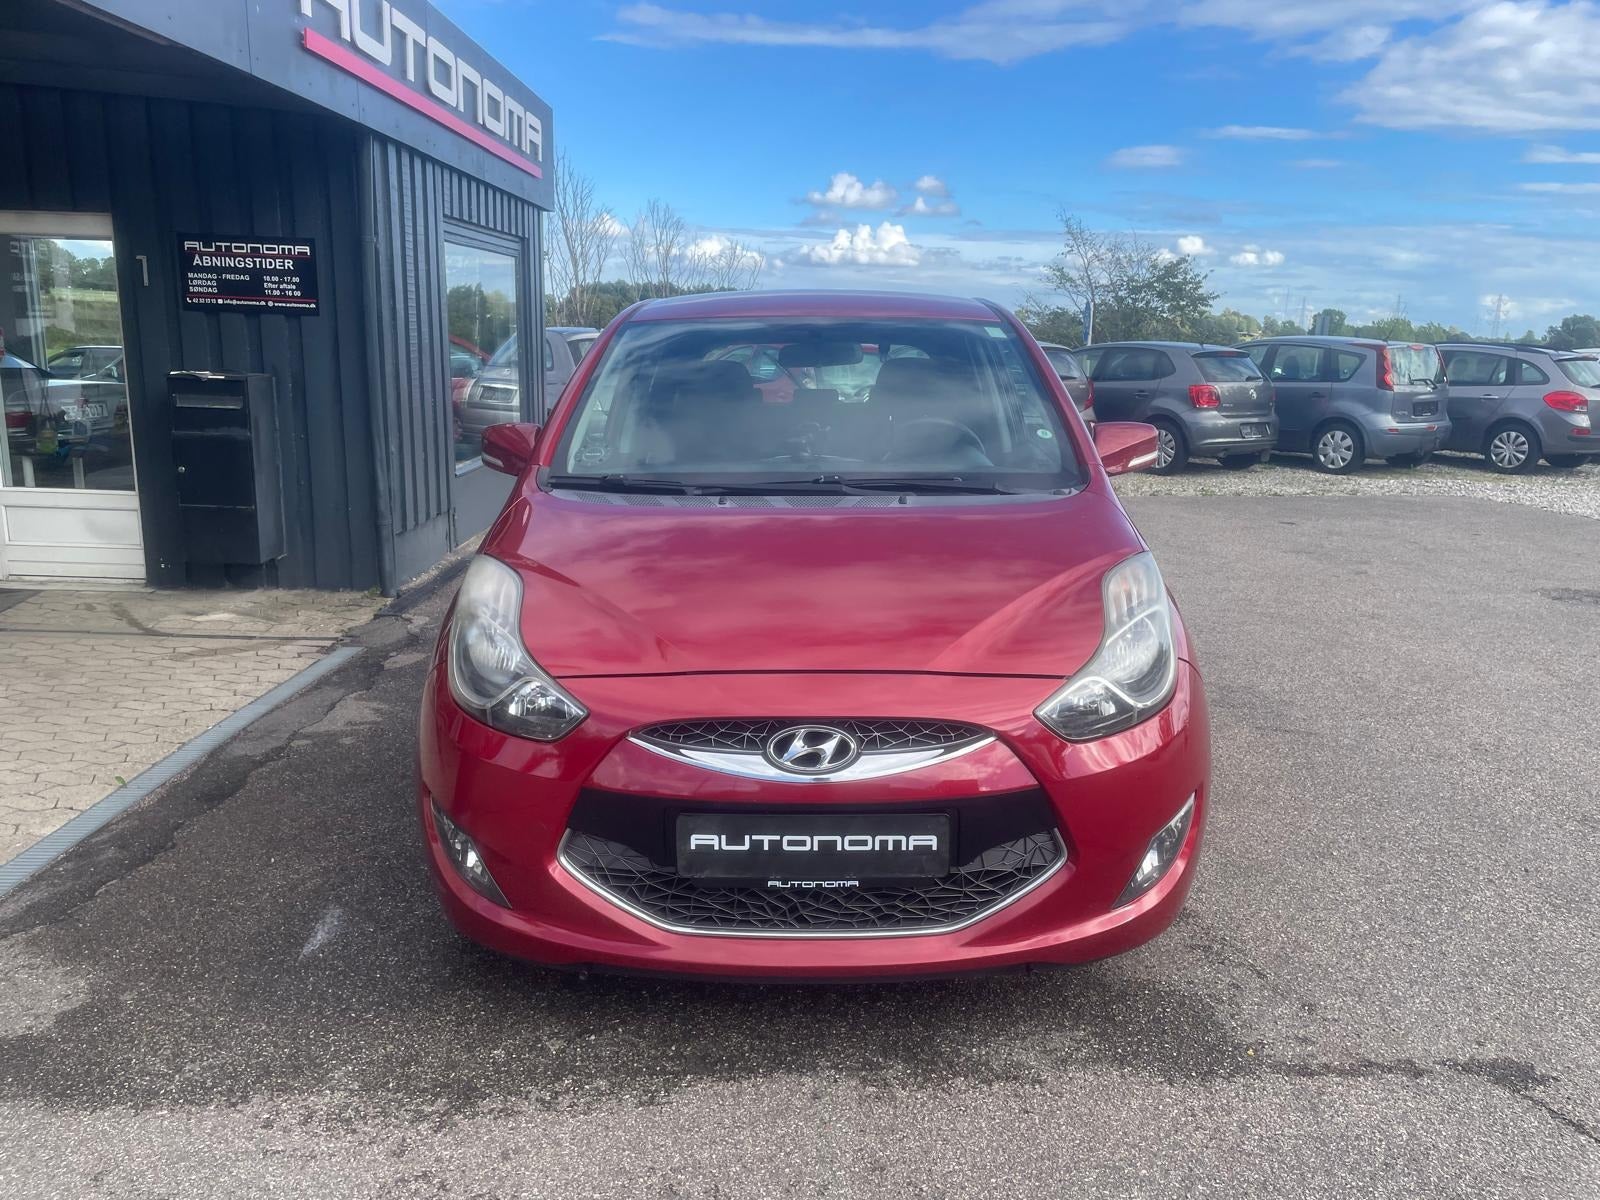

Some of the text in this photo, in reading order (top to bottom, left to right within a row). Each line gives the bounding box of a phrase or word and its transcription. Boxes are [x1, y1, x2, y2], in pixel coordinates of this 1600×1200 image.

[184, 241, 311, 256] AUTONOMA
[193, 253, 294, 270] ÅBNINGSTIDER
[690, 834, 938, 851] AUTONOMA
[767, 880, 860, 888] AUTONOMA
